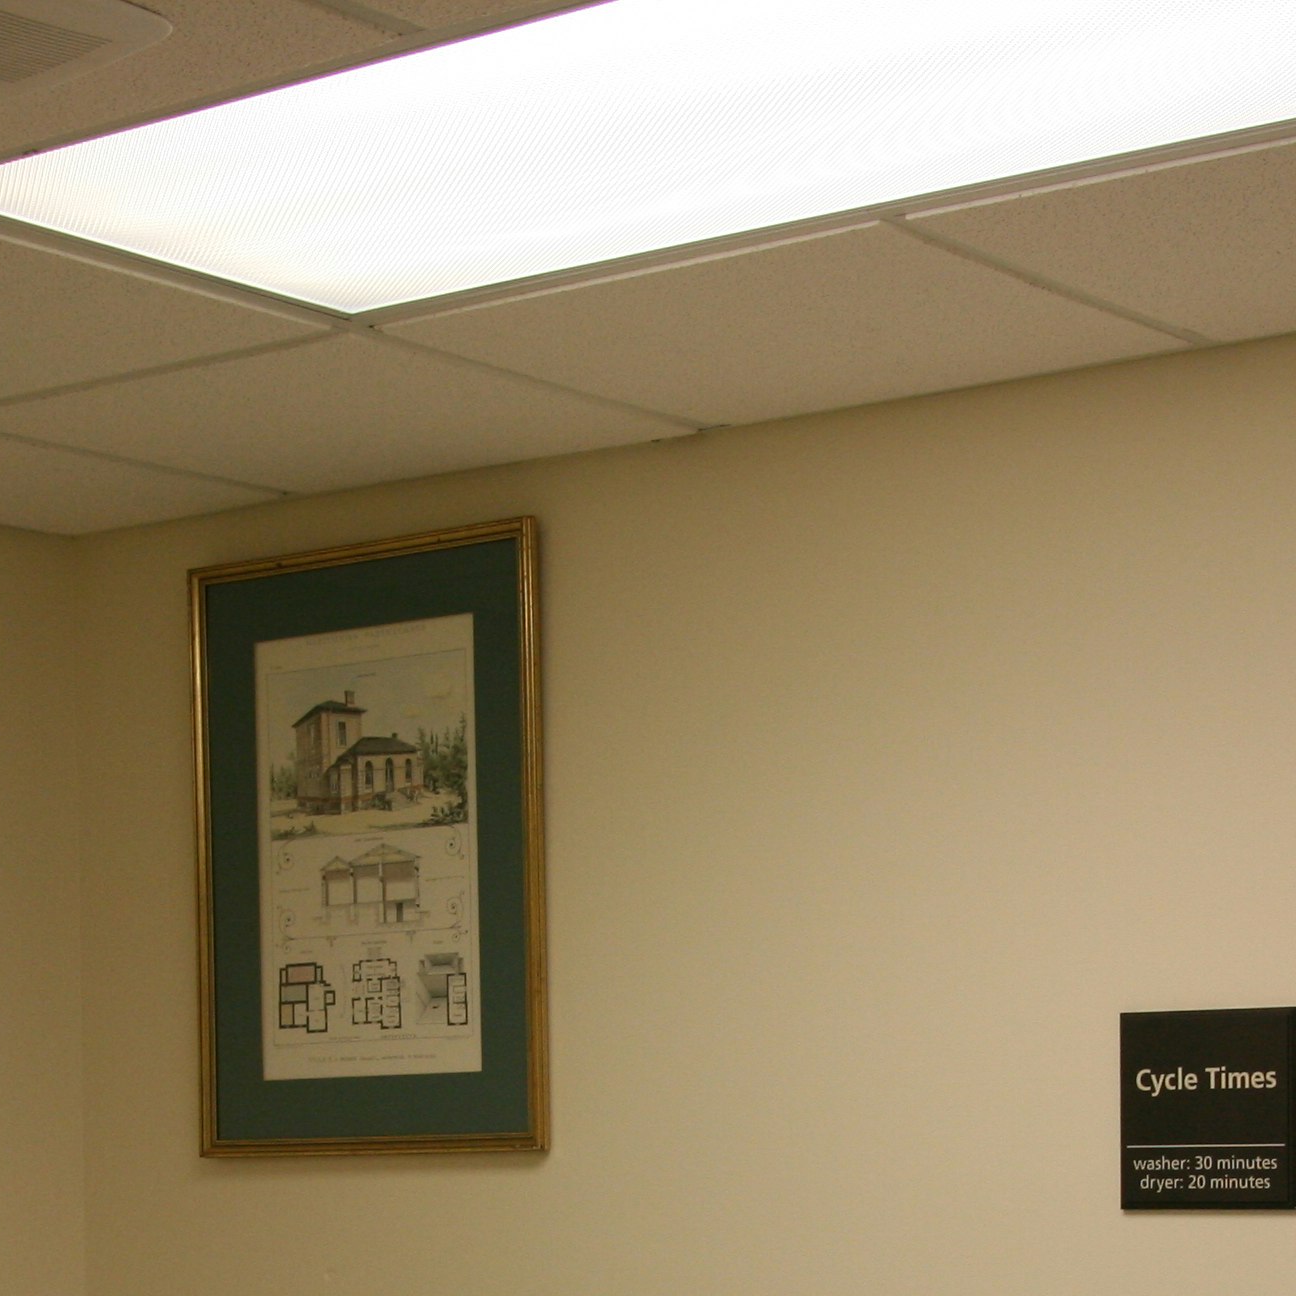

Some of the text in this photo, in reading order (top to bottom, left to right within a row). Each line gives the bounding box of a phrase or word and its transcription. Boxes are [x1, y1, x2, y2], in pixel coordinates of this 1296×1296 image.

[1135, 1065, 1277, 1097] Cycle Times
[1133, 1154, 1278, 1171] washer: 30 minutes
[1140, 1174, 1271, 1193] dryer: 20 minutes
